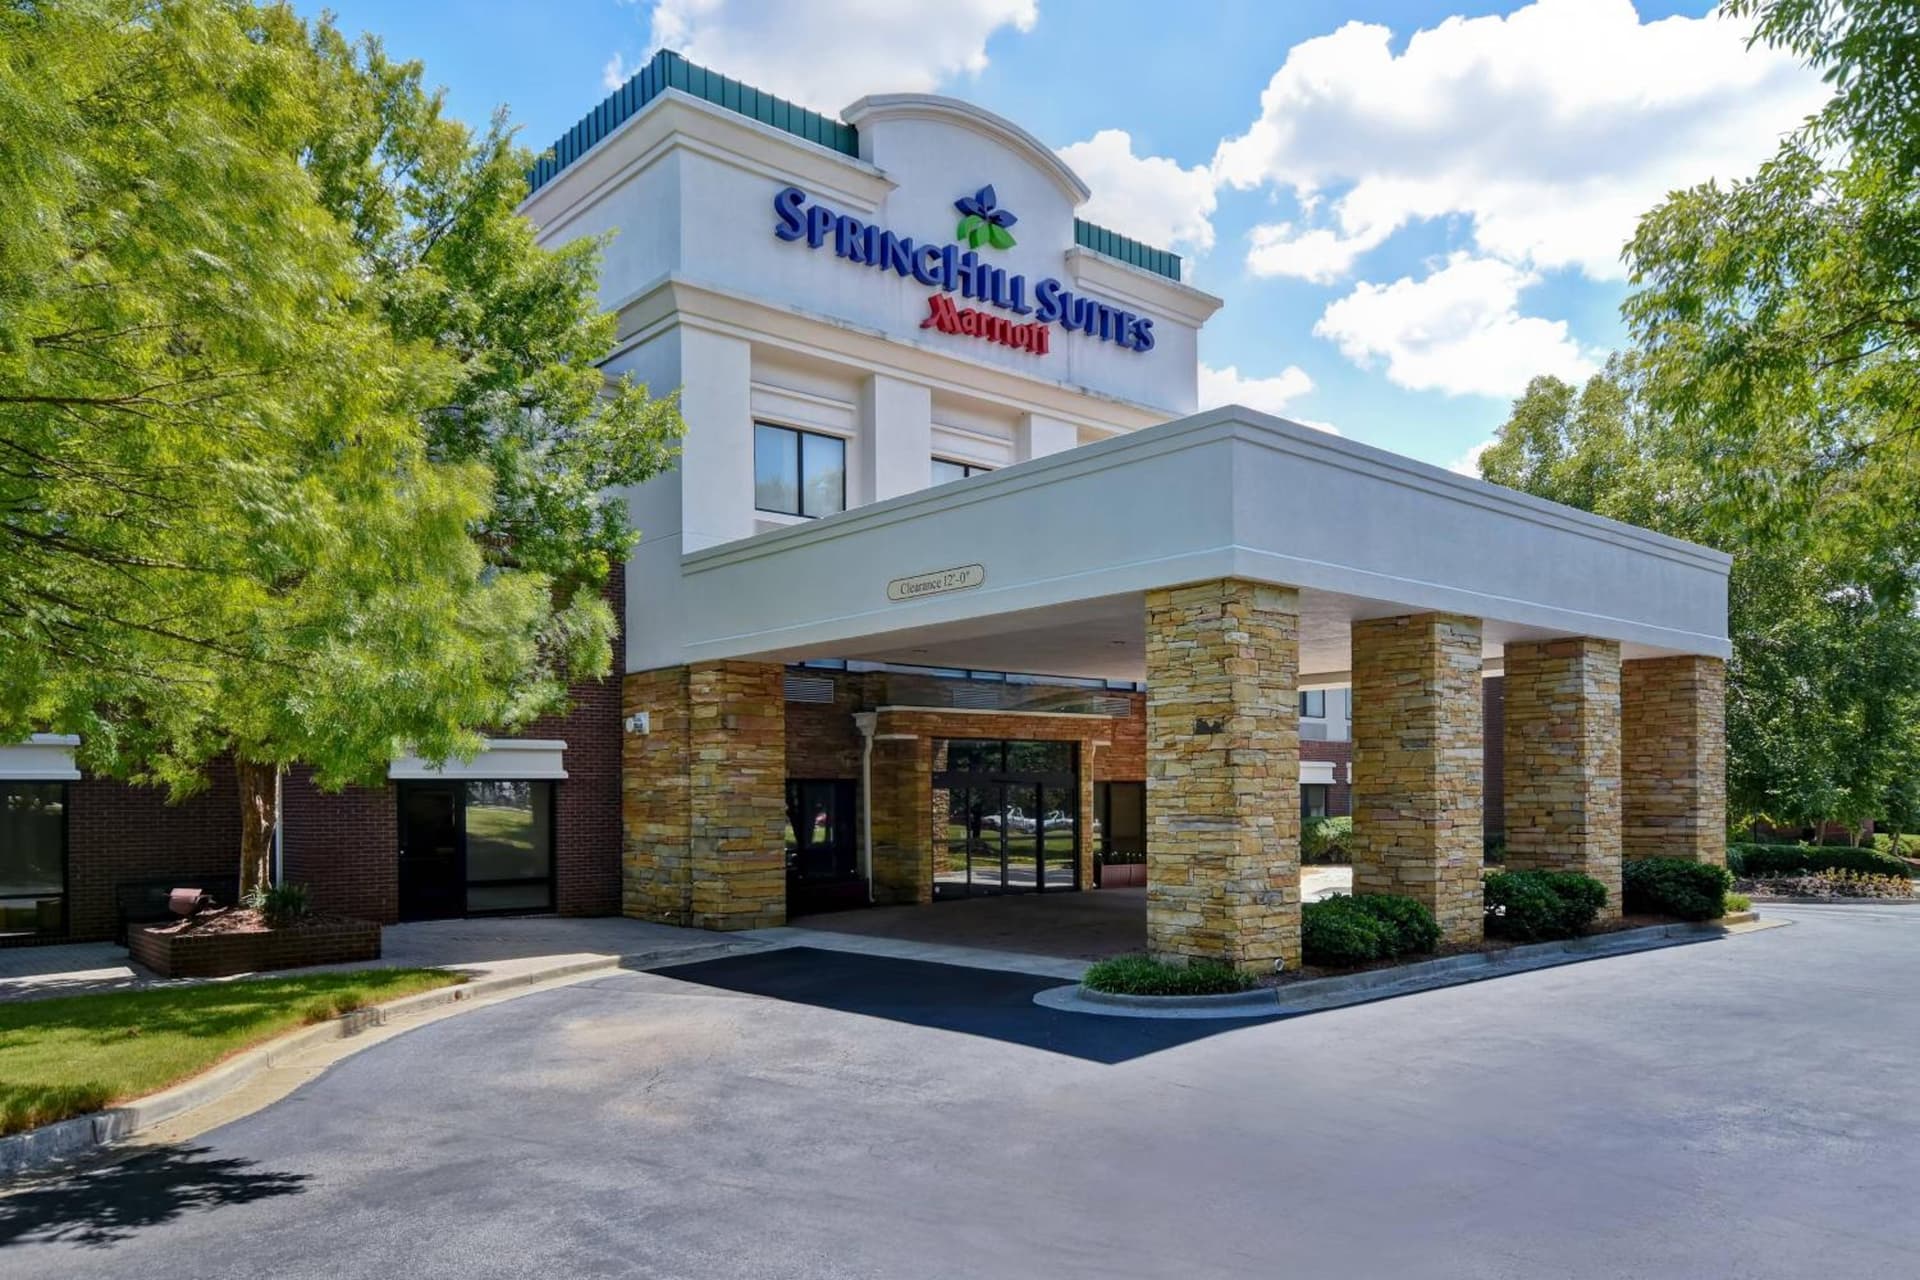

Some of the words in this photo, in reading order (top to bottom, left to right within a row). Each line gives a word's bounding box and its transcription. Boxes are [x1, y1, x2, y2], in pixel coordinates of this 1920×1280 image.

[920, 292, 1051, 355] Marriott
[1035, 277, 1156, 353] SUITES
[900, 579, 942, 595] Clearance
